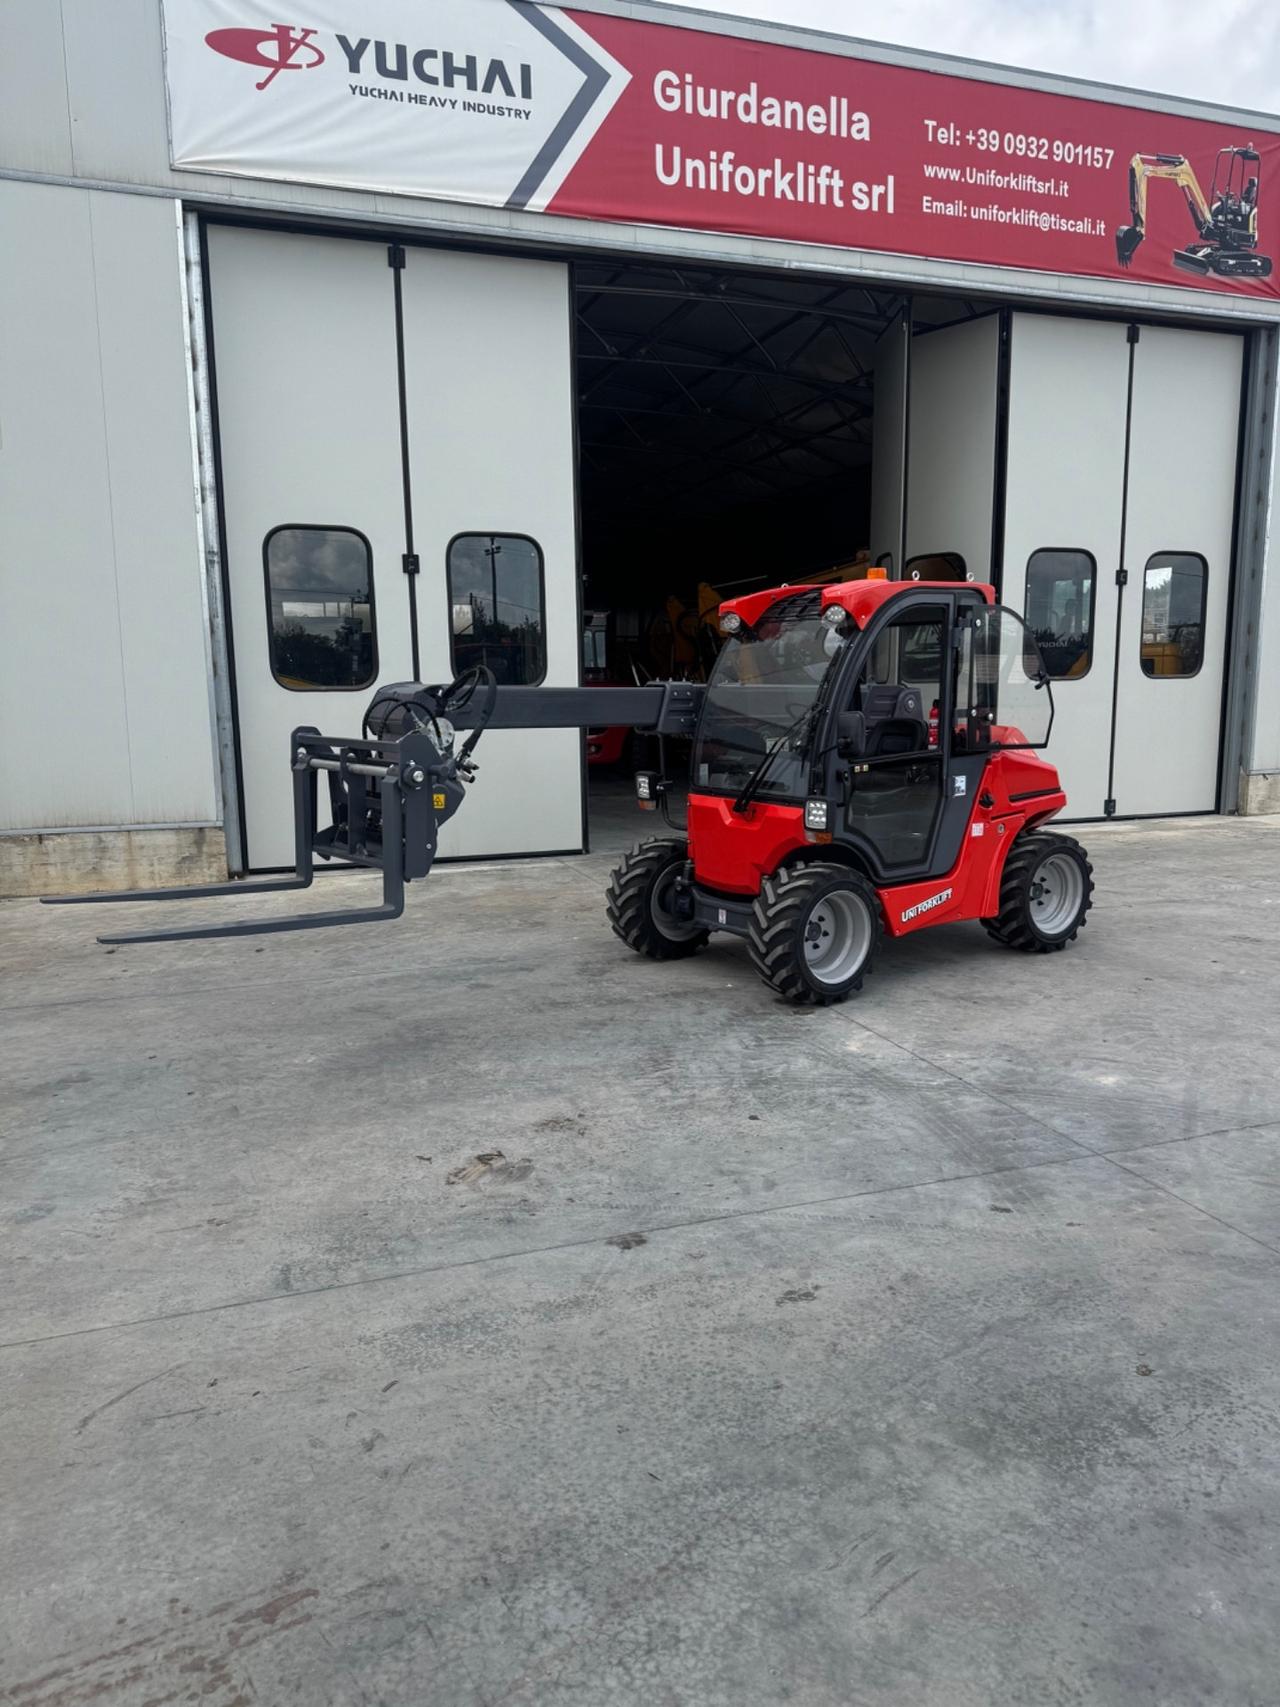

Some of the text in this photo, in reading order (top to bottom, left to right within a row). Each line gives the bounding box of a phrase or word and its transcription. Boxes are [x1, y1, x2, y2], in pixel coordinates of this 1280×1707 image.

[335, 34, 532, 99] YUCHAI
[349, 83, 532, 120] YUCHAI HEAVY INDUSTRY
[653, 69, 870, 141] Giurdanella
[924, 119, 1115, 169] Tel: +39 0932 901157
[655, 143, 895, 214] Uniforklift srl
[923, 164, 1069, 197] www.Uniforkliftsrl.it
[922, 196, 1106, 236] Email: uniforklift@tiscali.it
